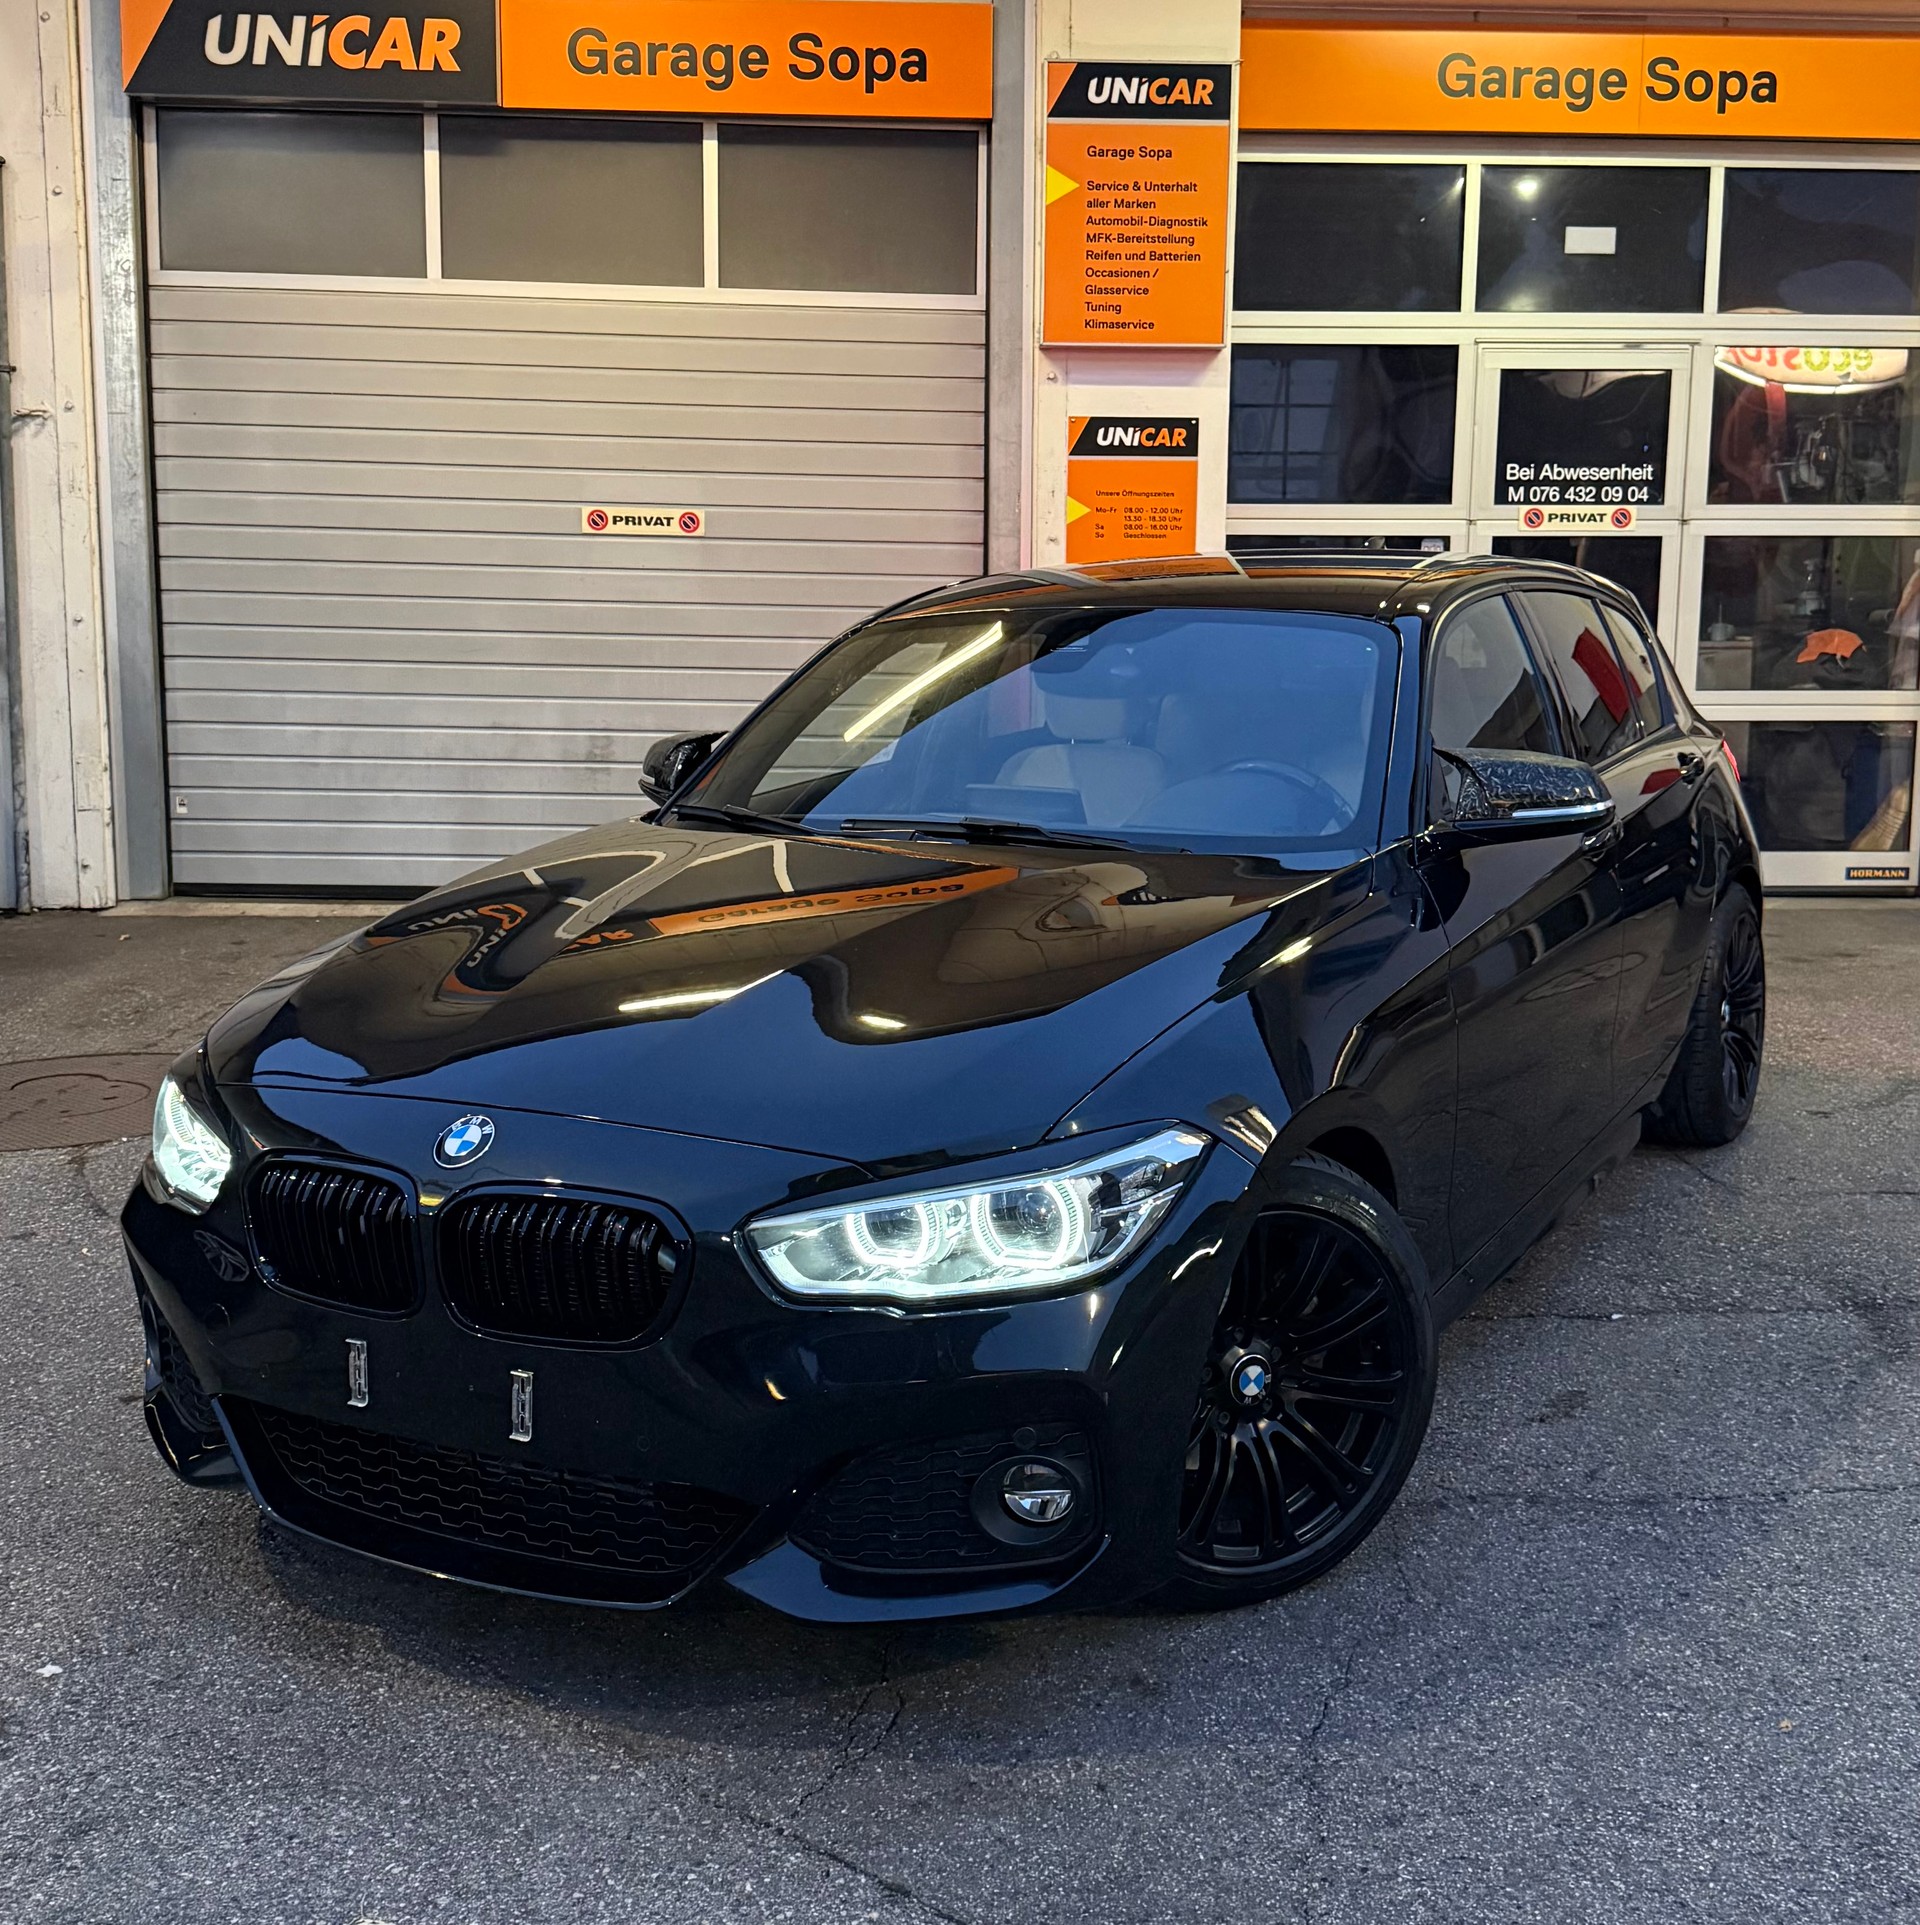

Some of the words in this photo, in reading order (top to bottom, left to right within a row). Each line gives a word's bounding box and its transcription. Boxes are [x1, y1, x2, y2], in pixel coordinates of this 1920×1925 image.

[566, 27, 769, 91] Garage
[788, 32, 928, 94] Sopa
[1437, 52, 1628, 112] Garage
[1645, 55, 1778, 114] Sopa
[1087, 145, 1135, 160] Garage
[1138, 146, 1173, 161] Sopa
[1086, 181, 1129, 192] Service
[1132, 181, 1141, 192] &
[1144, 181, 1198, 192] Unterhalt
[1086, 198, 1111, 209] aller
[1113, 198, 1156, 209] Marken
[1086, 215, 1208, 229] Automobil-Diagnostik
[1086, 233, 1195, 246] MFK-Bereitstellung
[1086, 250, 1122, 261] Reifen
[1125, 251, 1146, 261] und
[1149, 251, 1201, 262] Batterien
[1085, 267, 1150, 278] Occasionen
[1085, 284, 1150, 295] Glasservice
[1084, 301, 1122, 314] Tuning
[1084, 319, 1155, 330] Klimaservice
[1506, 463, 1534, 481] Bei
[1539, 463, 1654, 481] Abwesenheit
[1121, 489, 1175, 498] Öffnungszeiten
[1508, 486, 1524, 502] M
[1529, 486, 1560, 502] 076
[1564, 486, 1596, 502] 432
[1601, 486, 1623, 502] 09
[1627, 486, 1649, 502] 04
[612, 515, 675, 526] PRIVAT
[1547, 512, 1608, 523] PRIVAT
